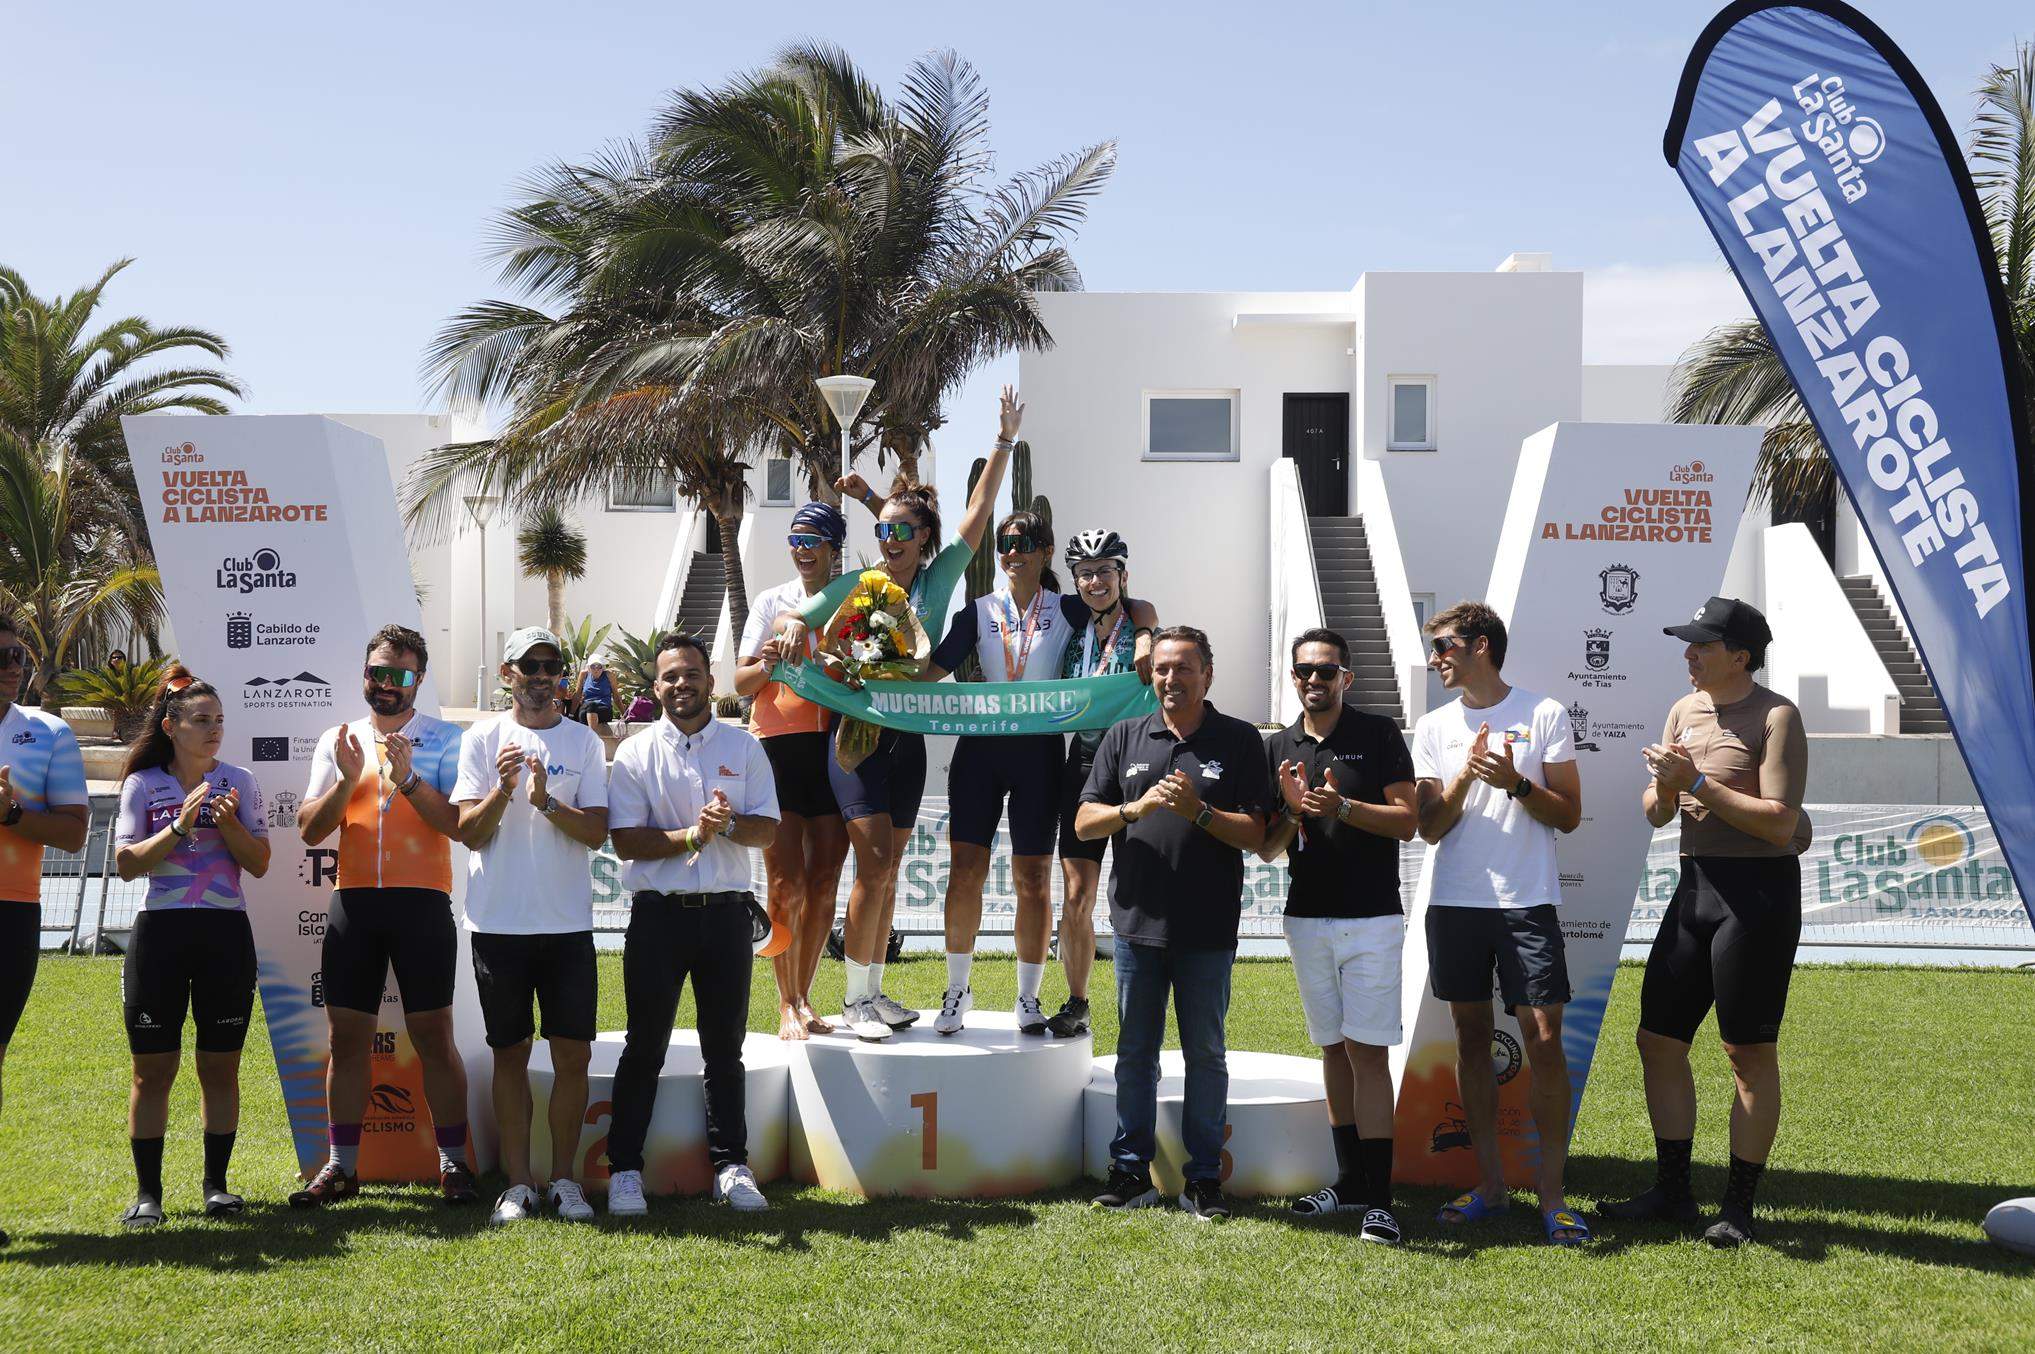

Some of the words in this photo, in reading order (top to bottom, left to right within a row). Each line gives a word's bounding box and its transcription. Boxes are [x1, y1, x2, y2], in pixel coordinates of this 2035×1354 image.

[1820, 76, 1856, 126] Club
[1693, 129, 1749, 188] A
[1727, 184, 1946, 568] LANZAROTE
[1742, 97, 1881, 337] VUELTA
[1865, 335, 2011, 620] CICLISTA
[165, 446, 181, 455] Club
[1674, 464, 1690, 473] Club
[162, 471, 249, 488] VUELTA
[162, 488, 270, 505] CICLISTA
[1624, 489, 1713, 507] VUELTA
[163, 507, 181, 523] A
[186, 505, 328, 523] LANZAROTE
[1601, 506, 1712, 525] CICLISTA
[1541, 523, 1560, 540] A
[1566, 524, 1712, 544] LANZAROTE
[223, 557, 253, 572] Club
[256, 624, 302, 634] Cabildo
[305, 624, 320, 634] de
[256, 635, 316, 646] Lanzarote
[1567, 671, 1627, 681] Ayuntamiento
[244, 688, 332, 699] LANZAROTE
[277, 700, 333, 708] DESTINATION
[871, 691, 1000, 715] MUCHACHAS
[1009, 689, 1077, 715] BIKE
[929, 720, 1019, 731] Tenerife
[1592, 721, 1645, 730] Ayuntamiento
[1592, 730, 1602, 738] de
[1603, 731, 1627, 739] YAIZA
[1332, 754, 1363, 762] AURUM
[1833, 834, 1907, 866] Club
[1599, 920, 1612, 930] de
[910, 1092, 938, 1170] 1
